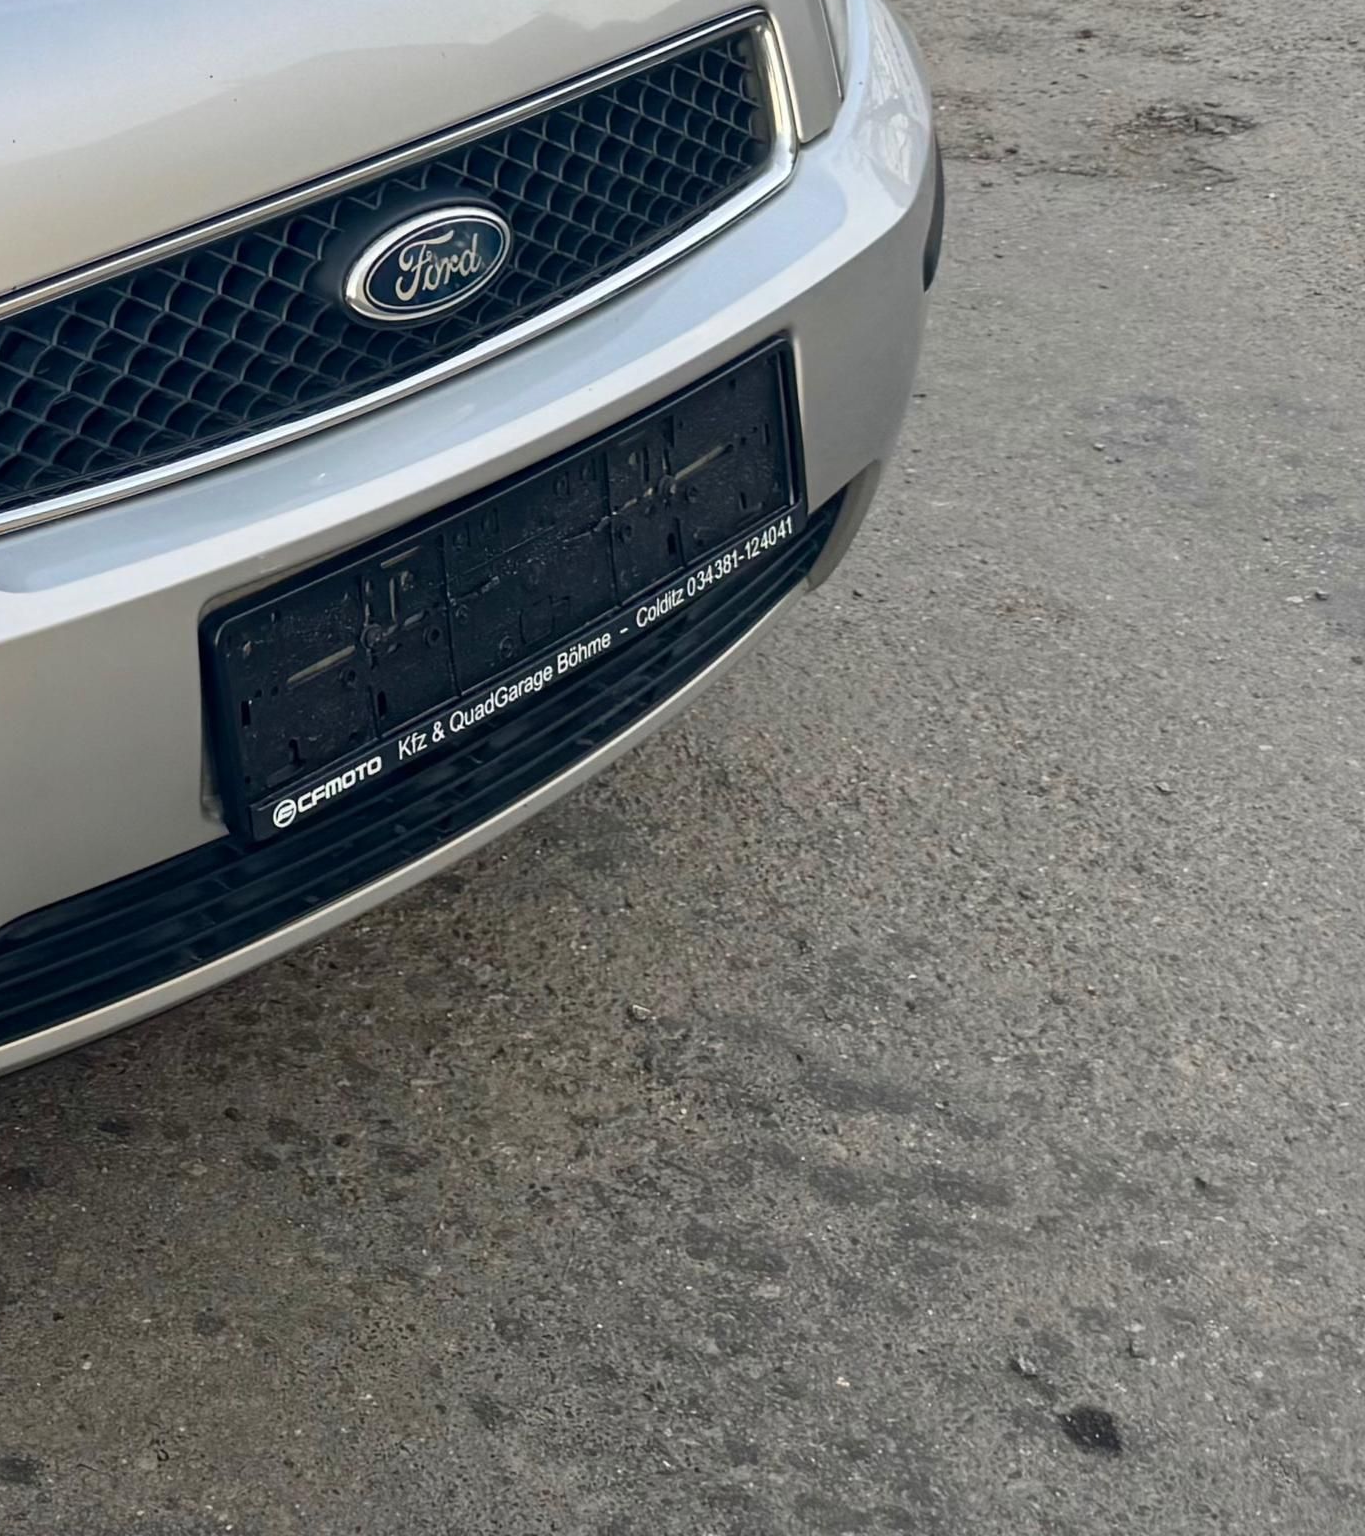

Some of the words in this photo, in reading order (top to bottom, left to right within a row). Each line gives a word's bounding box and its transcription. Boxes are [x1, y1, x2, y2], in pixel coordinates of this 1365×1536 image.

[395, 230, 481, 301] Ford
[297, 756, 382, 813] CFMOTO
[398, 733, 428, 760] Kfz
[432, 721, 446, 743] &
[449, 664, 553, 733] QuadGarage
[557, 633, 612, 674] Böhme
[636, 587, 685, 628] Colditz
[687, 515, 793, 597] 034381-124041
